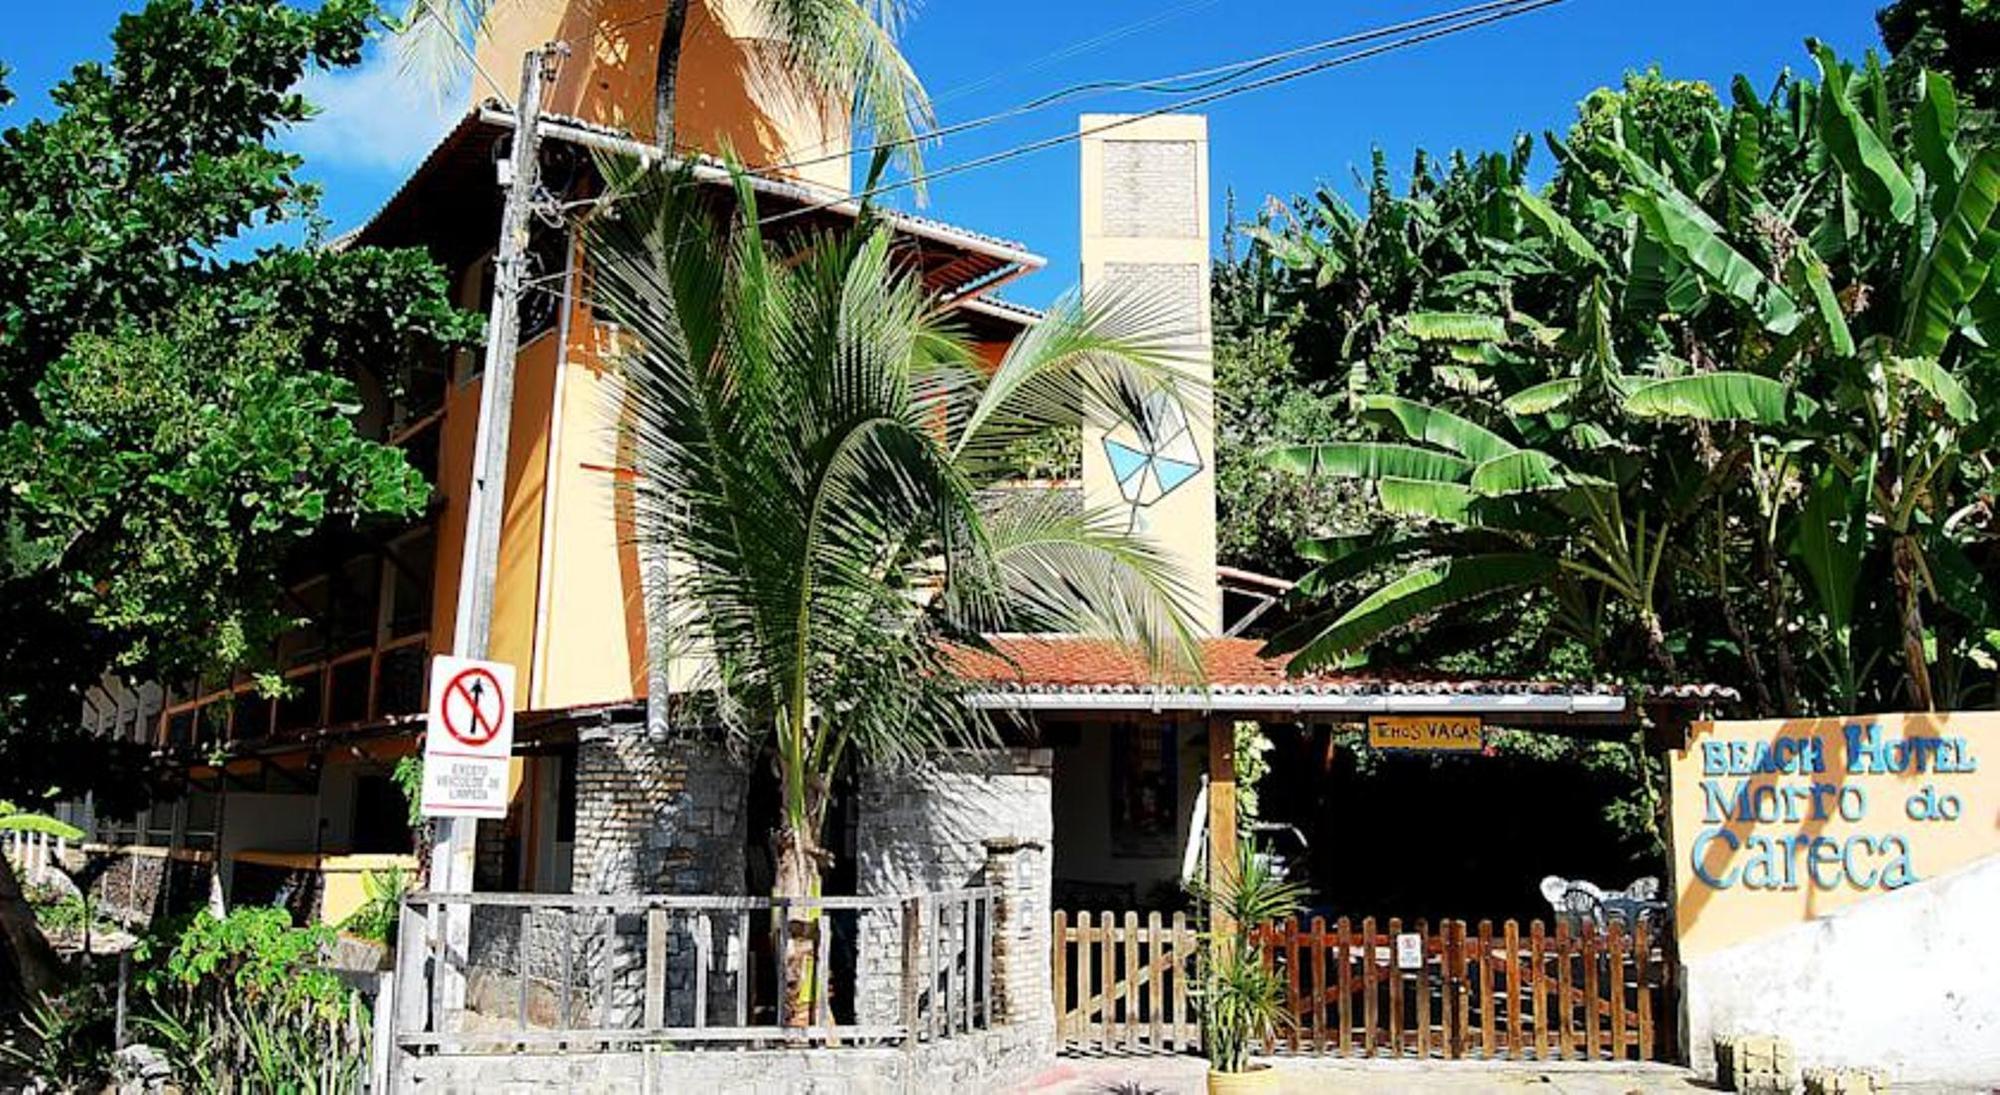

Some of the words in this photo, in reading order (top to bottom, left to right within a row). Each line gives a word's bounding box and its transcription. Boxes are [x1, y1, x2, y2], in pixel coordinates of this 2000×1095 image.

[1427, 721, 1479, 740] VAGAS
[1701, 735, 1827, 776] BEACH
[1844, 723, 1978, 775] HOTEL
[1699, 779, 1868, 824] Morro
[1905, 784, 1962, 822] do
[1690, 826, 1923, 891] Careca
